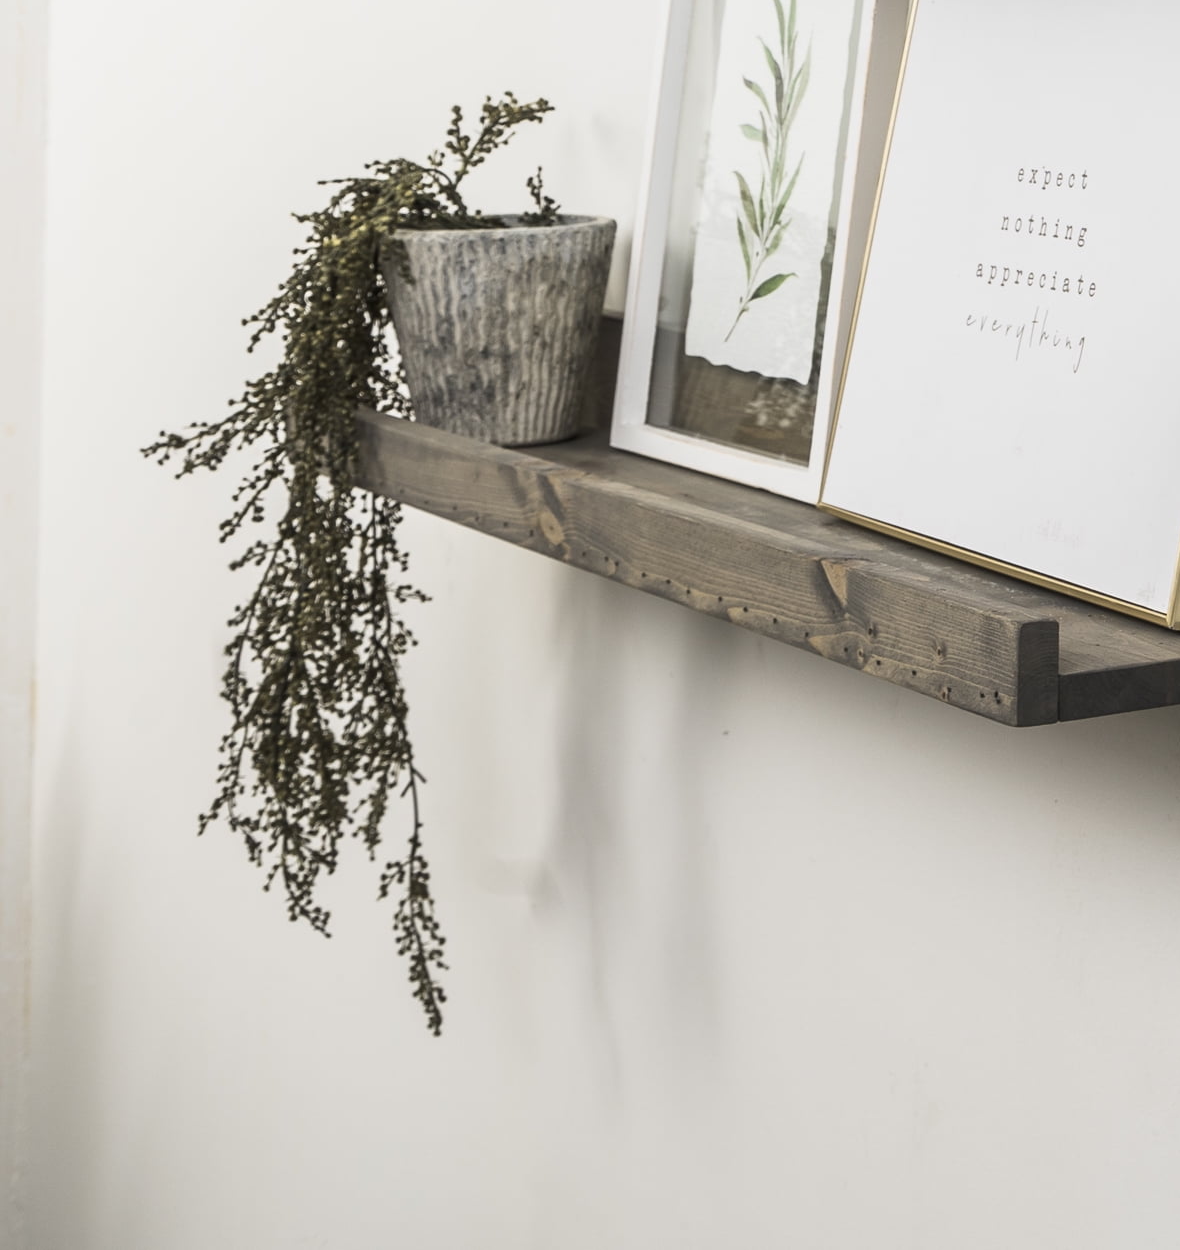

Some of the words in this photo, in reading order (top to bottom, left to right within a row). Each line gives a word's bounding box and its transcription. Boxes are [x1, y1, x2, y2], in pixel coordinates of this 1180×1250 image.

[1017, 167, 1088, 190] expect
[1001, 214, 1088, 247] nothing
[975, 262, 1097, 297] appreciate
[966, 305, 1085, 374] everything
